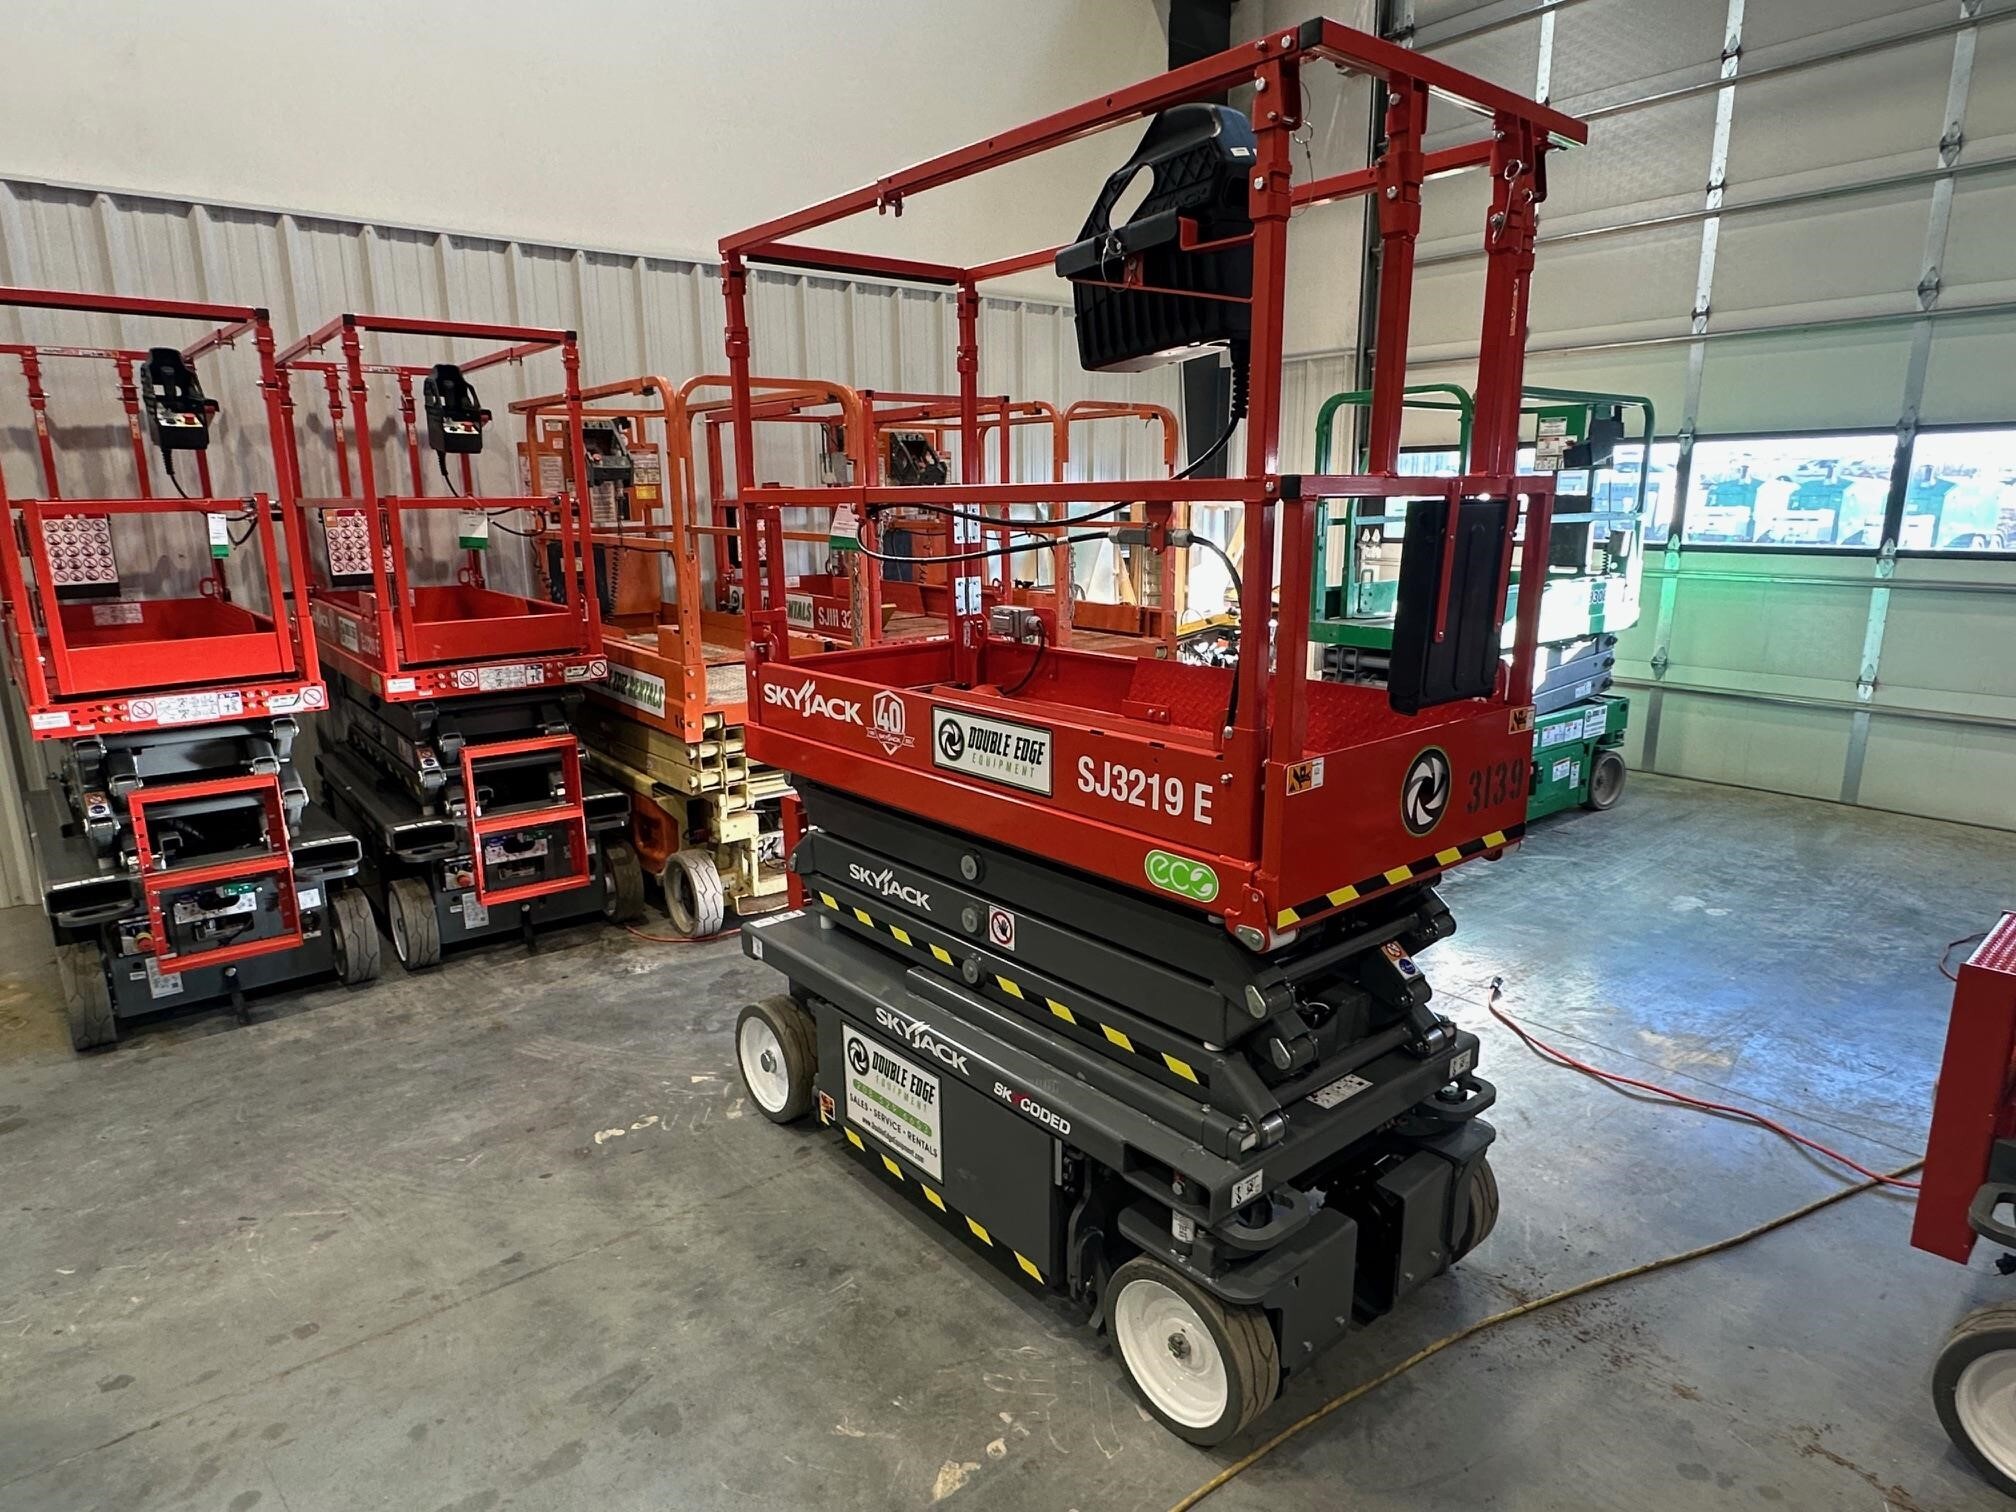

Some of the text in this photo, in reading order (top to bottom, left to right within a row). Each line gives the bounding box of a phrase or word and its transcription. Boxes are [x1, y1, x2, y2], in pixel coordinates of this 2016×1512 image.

[787, 600, 812, 622] NTALS
[763, 679, 864, 726] SKYJACK
[877, 697, 901, 734] 40
[967, 726, 1046, 765] DOUBLE EDGE
[972, 752, 1035, 778] EQUIPMENT
[1077, 755, 1213, 825] SJ3219 E
[1466, 758, 1525, 814] 3139
[849, 863, 932, 912] SKYJACK
[1150, 855, 1213, 897] eco
[875, 1006, 970, 1076] SKYJACK
[871, 1051, 908, 1088] DOUBLE
[910, 1074, 936, 1105] EDGE
[850, 1093, 869, 1112] SALES
[873, 1107, 902, 1134] SERVICE
[908, 1130, 938, 1158] RENTALS
